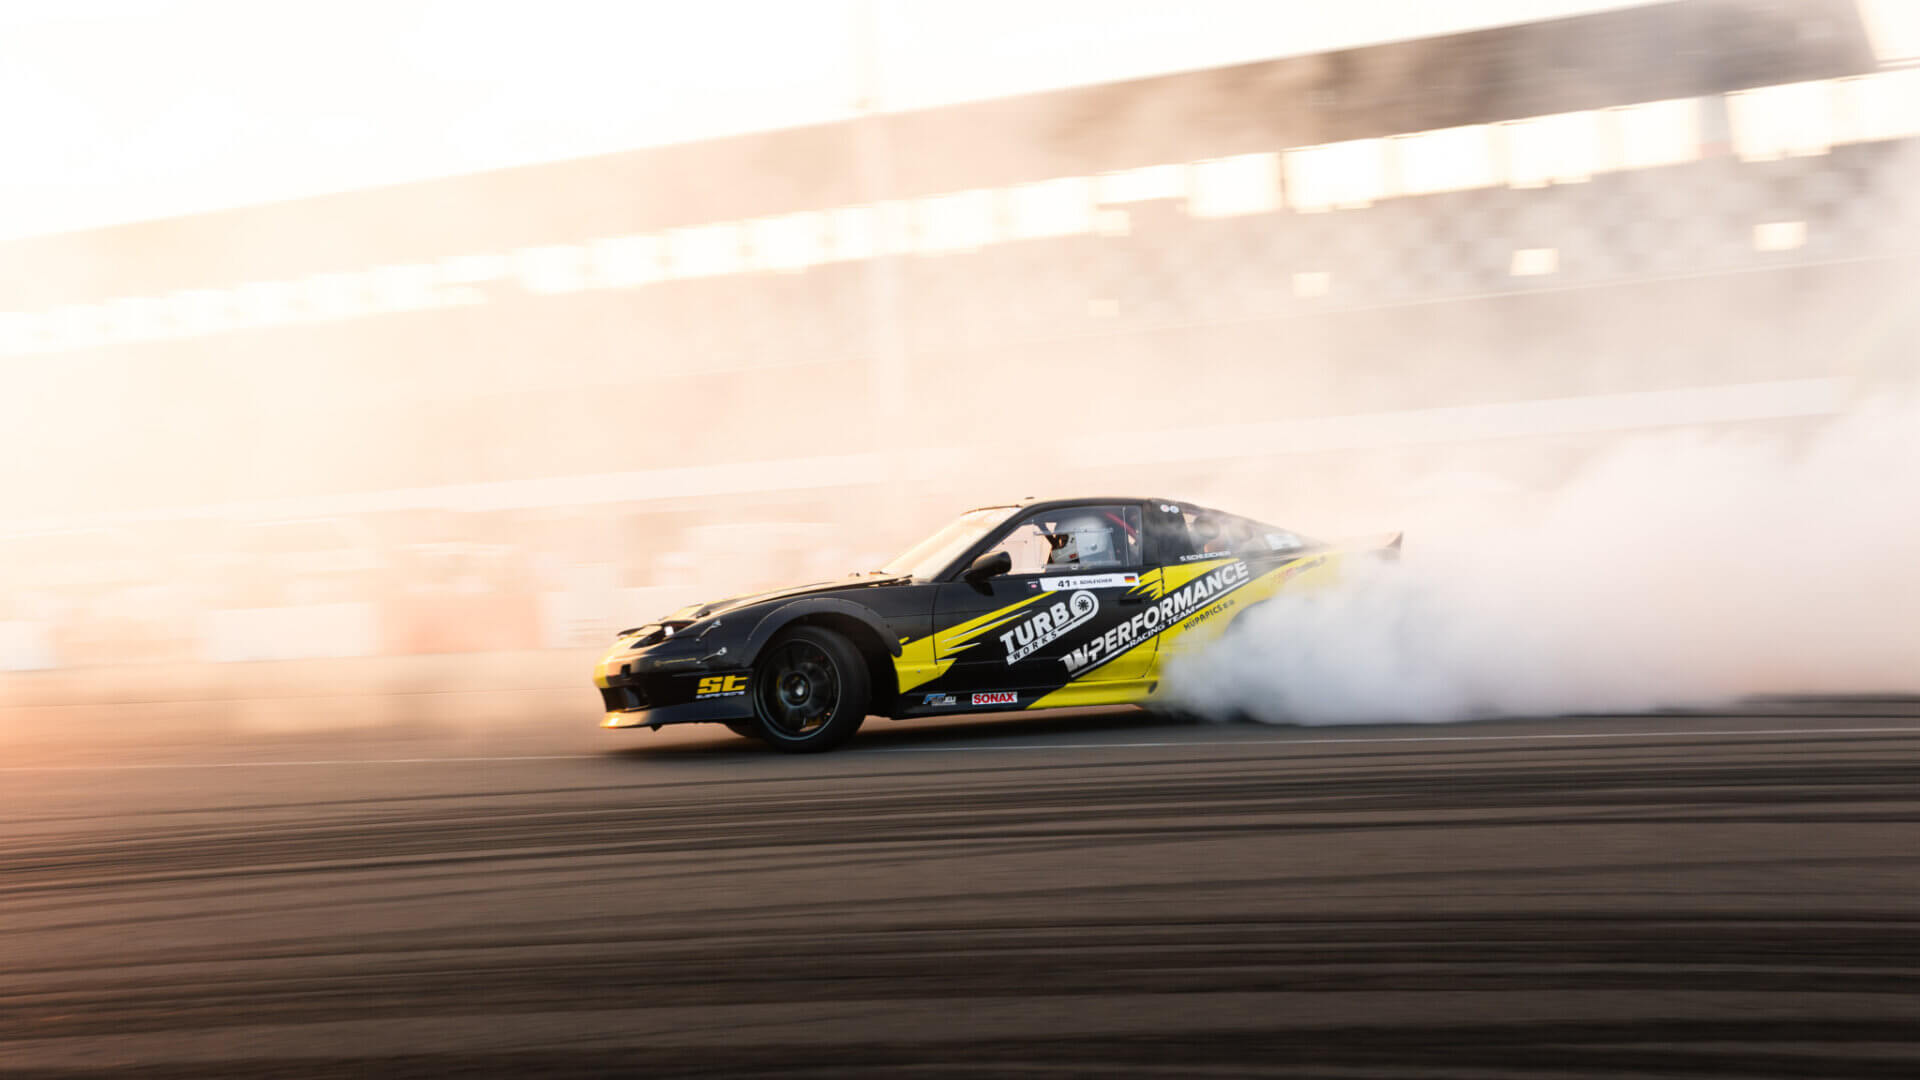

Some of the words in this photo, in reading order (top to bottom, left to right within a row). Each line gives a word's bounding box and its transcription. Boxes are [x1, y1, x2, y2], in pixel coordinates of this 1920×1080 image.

[1129, 621, 1166, 648] RACING
[1166, 605, 1196, 628] TEAM
[1012, 631, 1058, 661] WORKS
[973, 693, 1015, 705] SONAX
